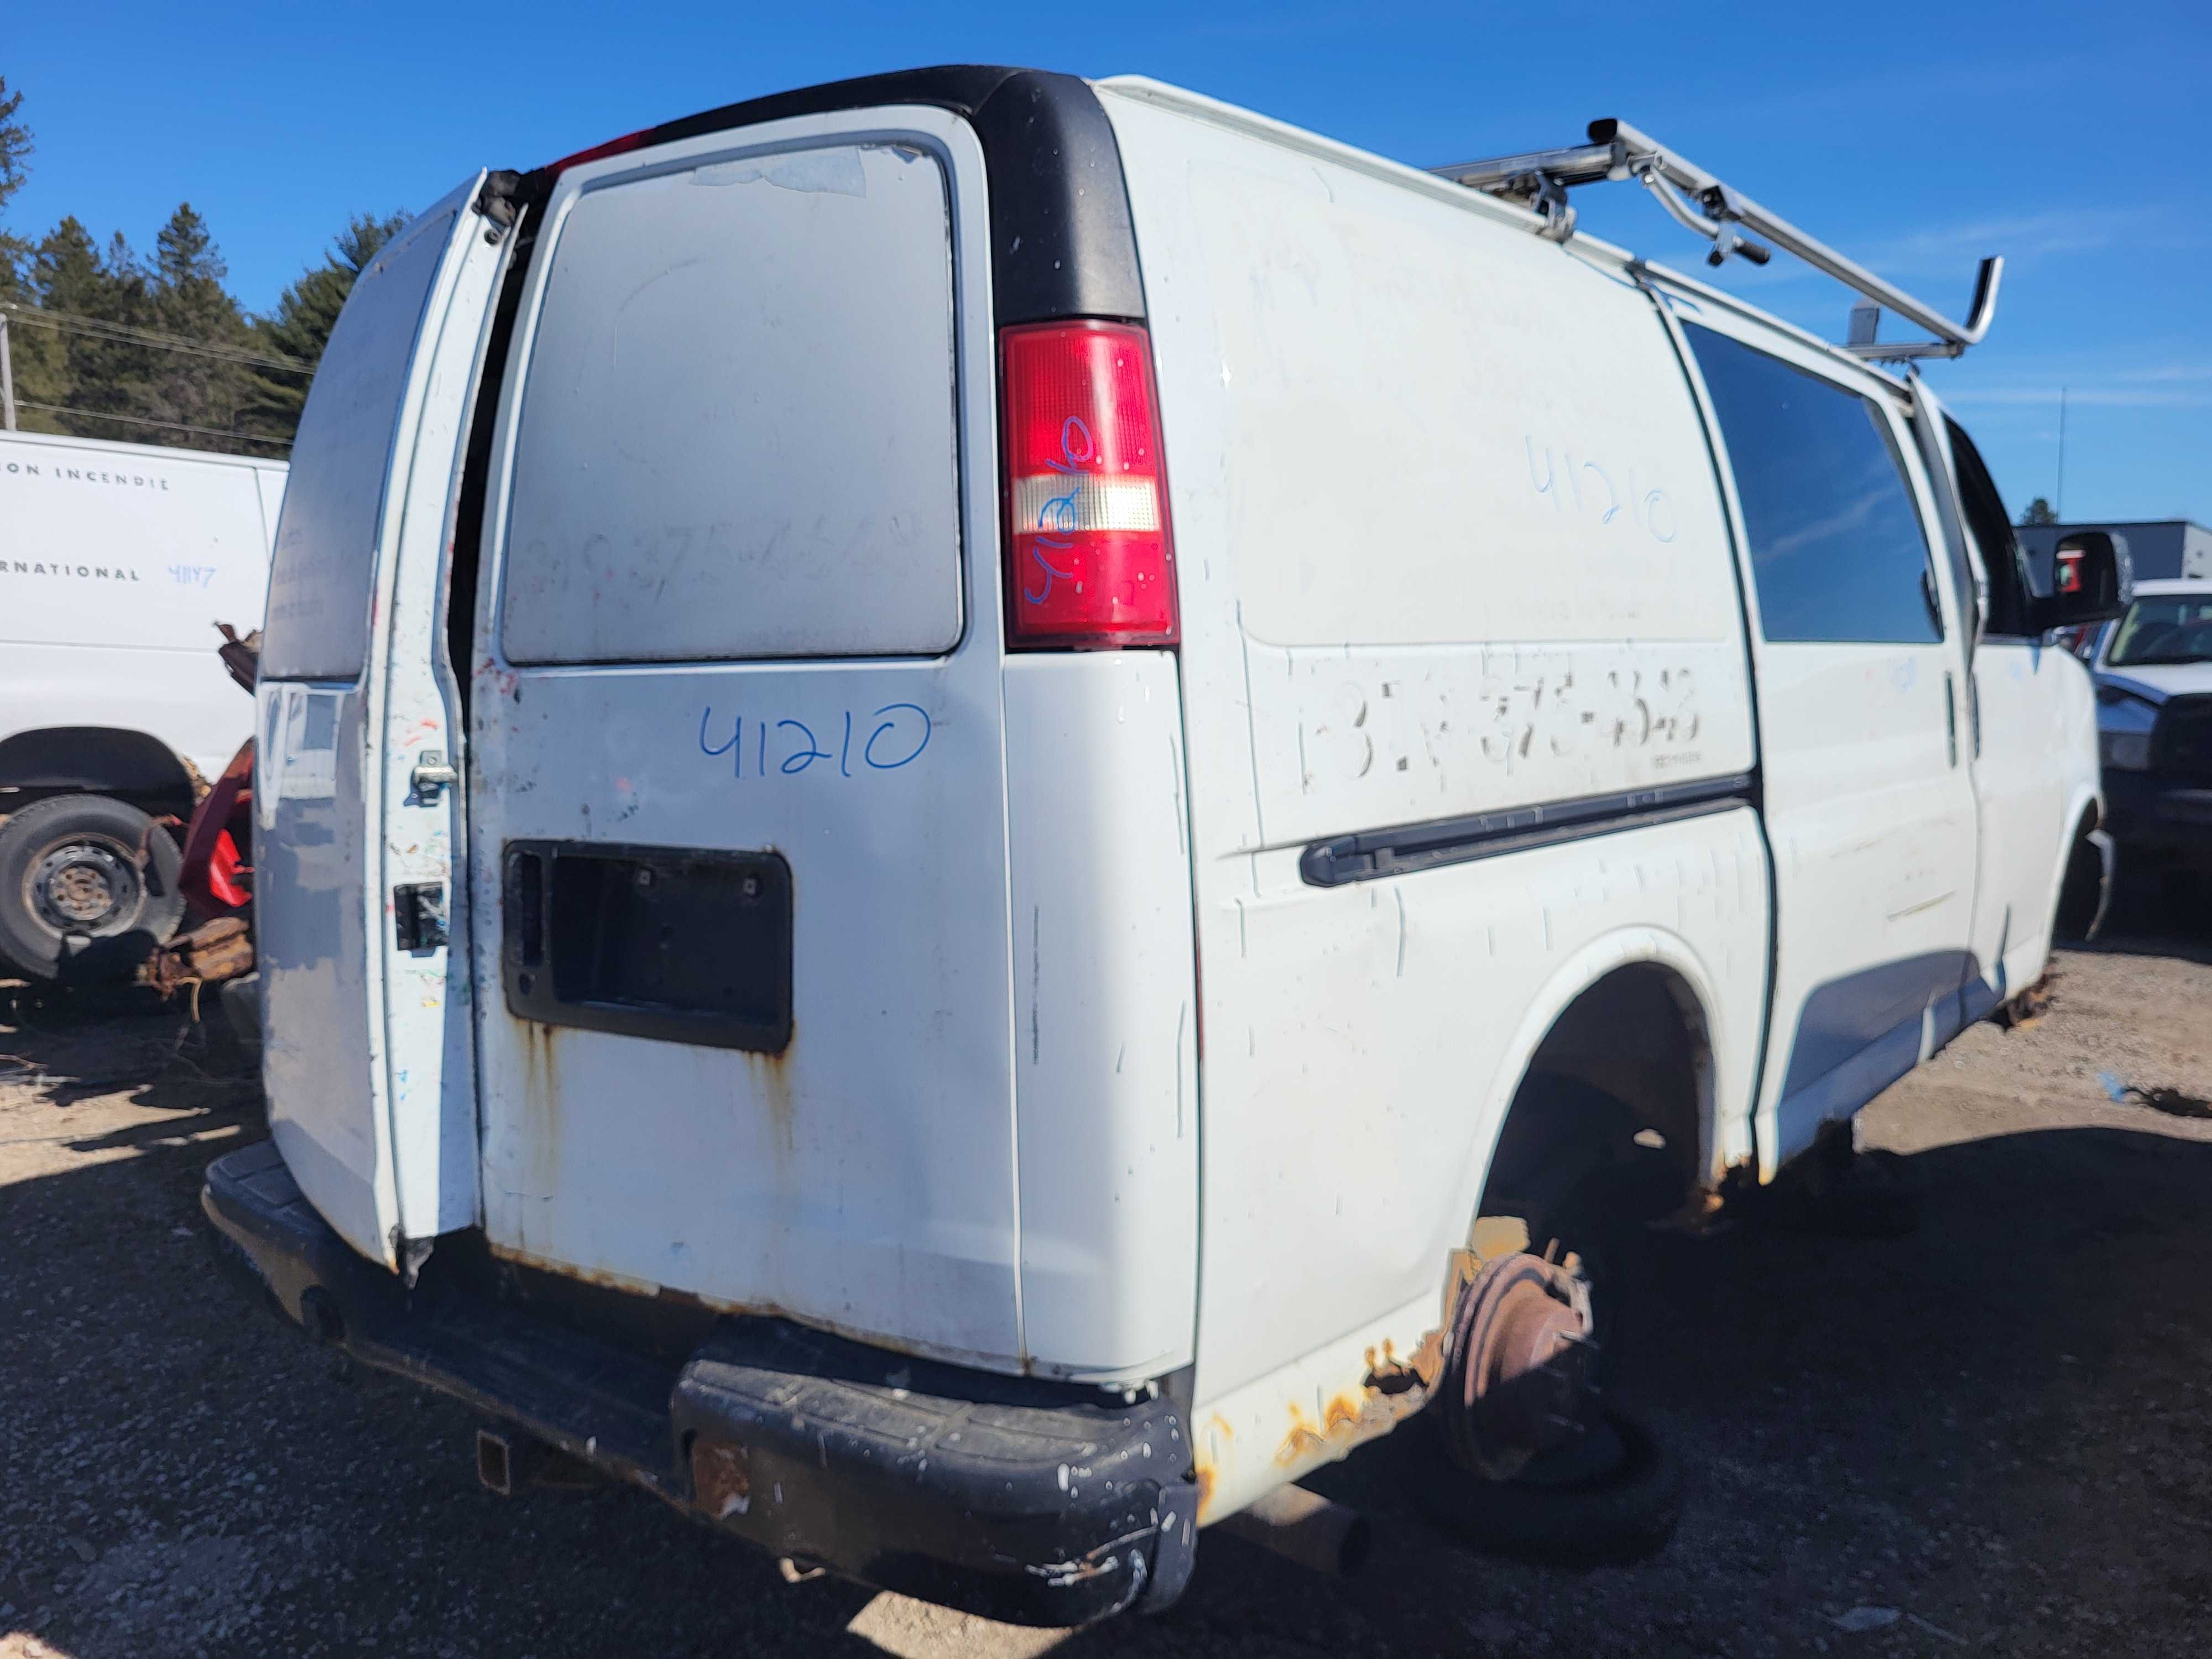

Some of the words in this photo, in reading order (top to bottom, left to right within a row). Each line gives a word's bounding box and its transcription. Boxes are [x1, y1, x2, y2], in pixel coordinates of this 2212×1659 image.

[0, 462, 40, 476] ON
[55, 467, 169, 491] INCENDIE
[1024, 415, 1094, 604] 41210
[1525, 433, 1678, 544] 41210
[0, 560, 140, 581] RNATIONAL
[700, 702, 932, 779] 41210
